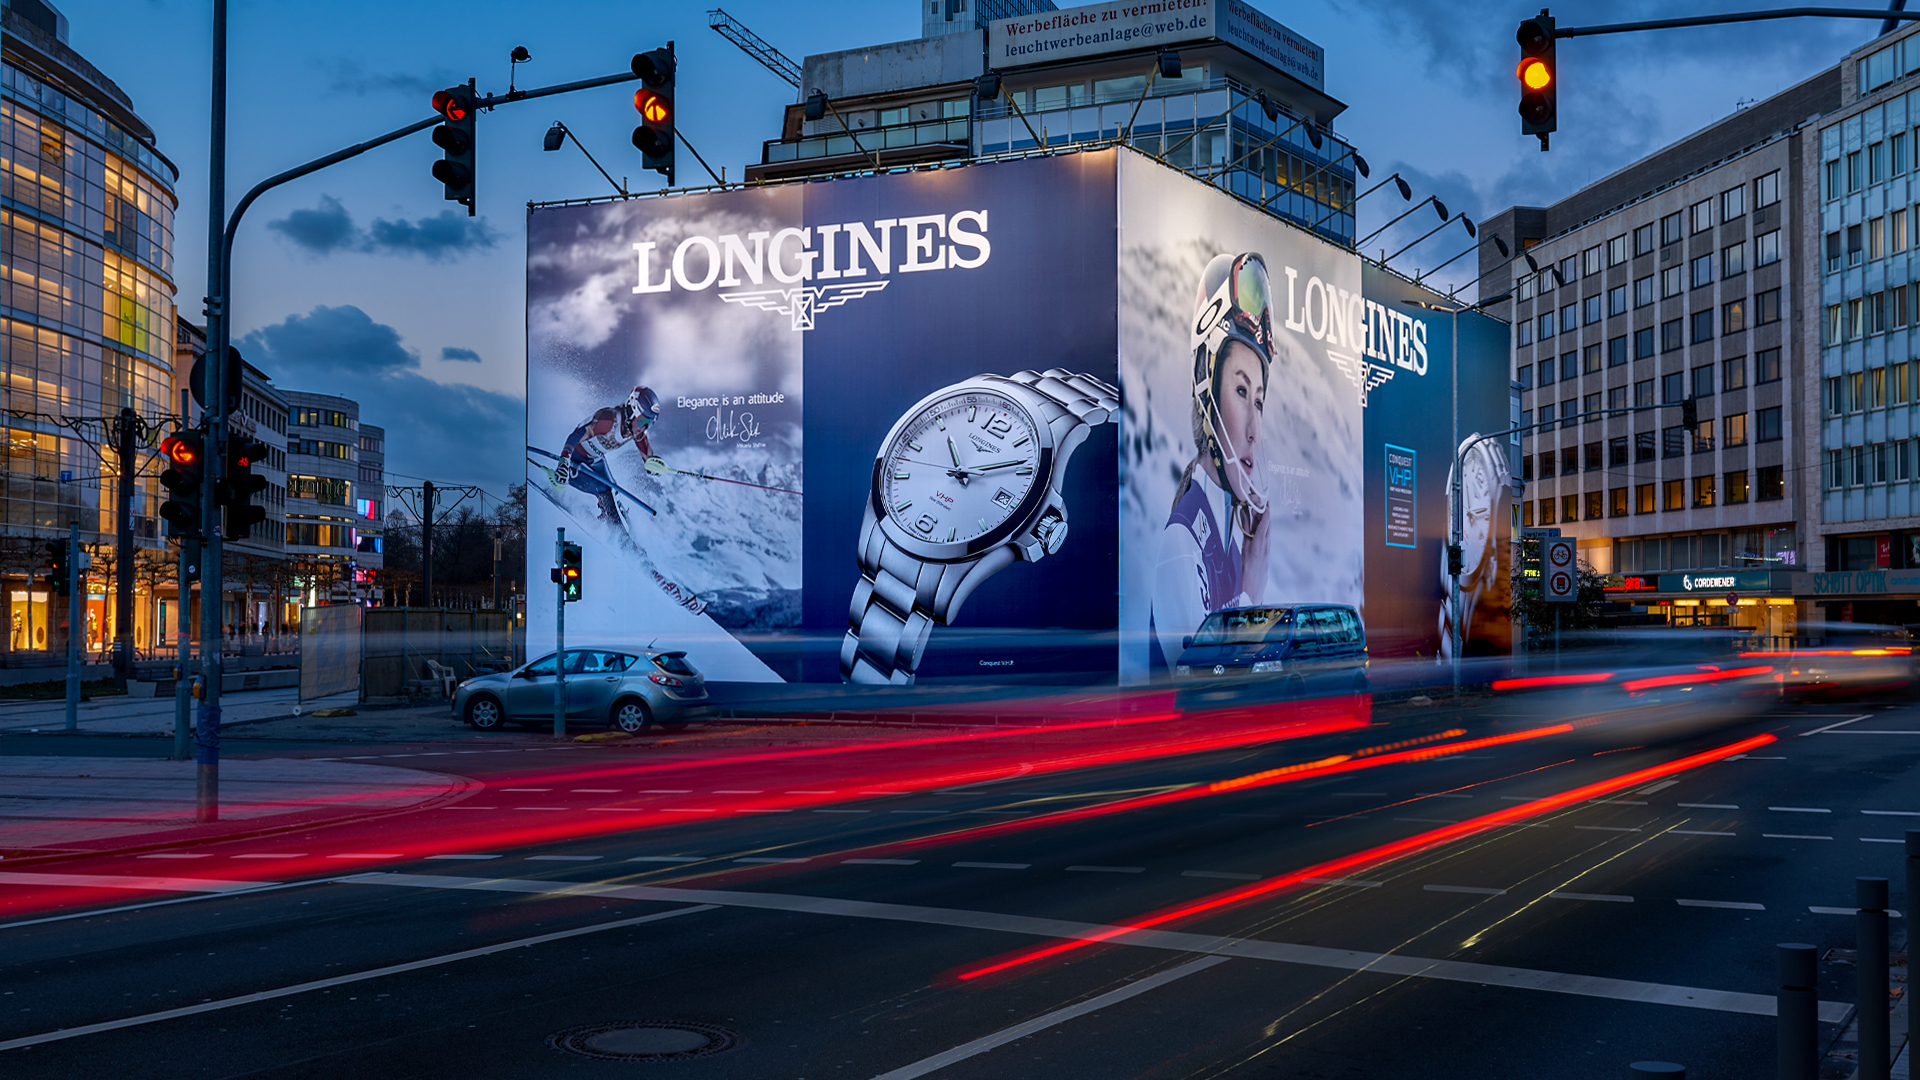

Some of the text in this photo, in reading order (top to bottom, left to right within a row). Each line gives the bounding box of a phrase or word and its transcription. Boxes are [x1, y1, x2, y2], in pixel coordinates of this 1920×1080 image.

[1005, 12, 1097, 37] Werbefläche
[1101, 9, 1118, 22] zu
[1005, 15, 1207, 57] leuchtwerbeanlage@web.de
[1227, 0, 1319, 61] Werbefläche zu vermieten!
[1227, 19, 1319, 81] leuchtwerbeanlage@web.de
[631, 209, 992, 294] LONGINES
[1285, 265, 1428, 376] LONGINES
[677, 391, 785, 410] Elegance is an attitude
[980, 411, 1013, 440] 12
[968, 432, 1002, 454] LONGINES
[1388, 453, 1413, 467] CONQUEST
[914, 511, 938, 534] 6
[1694, 577, 1735, 588] CORDEWENER
[1855, 571, 1888, 593] OPTIK
